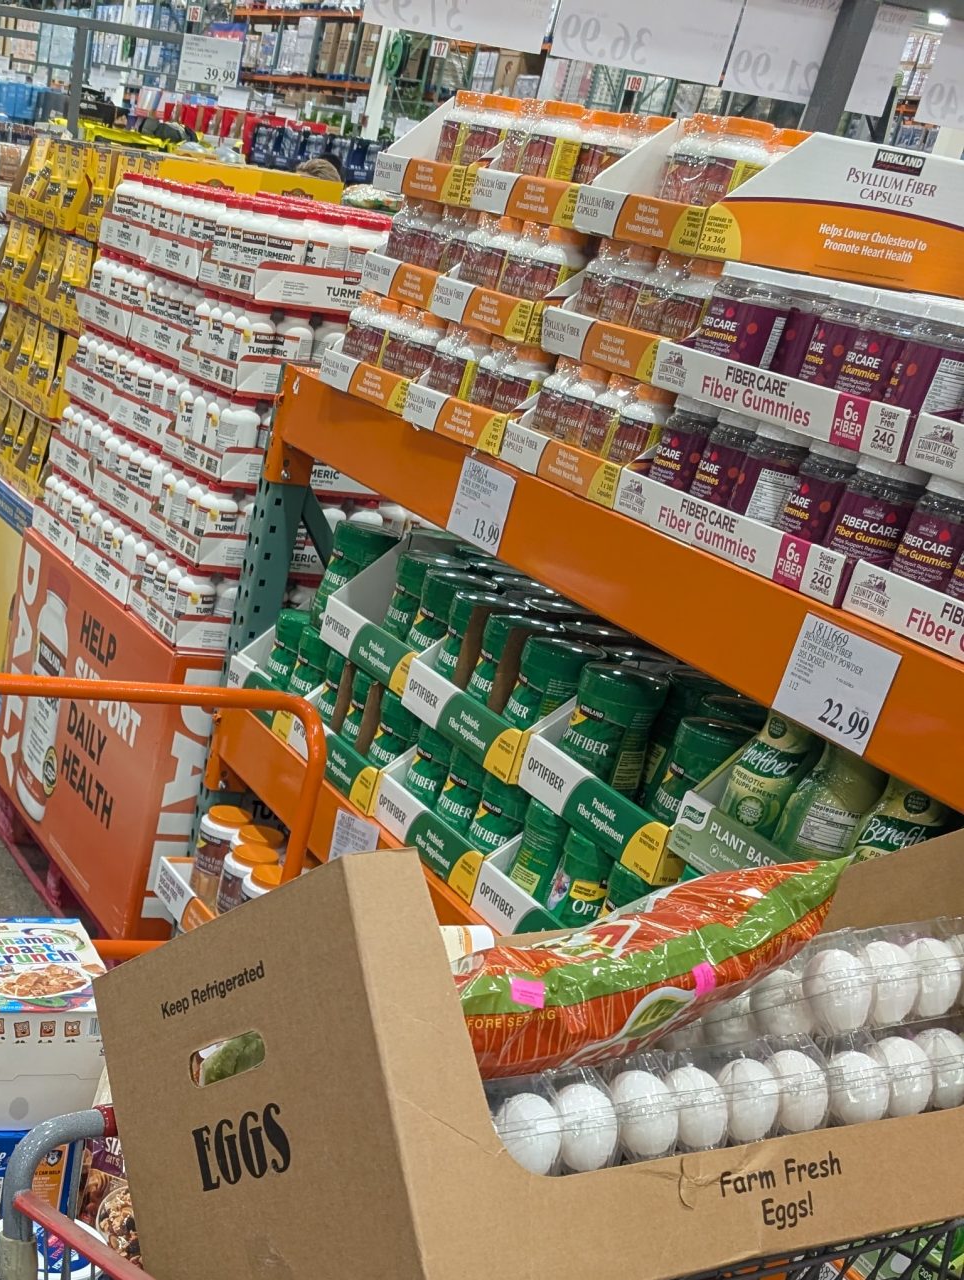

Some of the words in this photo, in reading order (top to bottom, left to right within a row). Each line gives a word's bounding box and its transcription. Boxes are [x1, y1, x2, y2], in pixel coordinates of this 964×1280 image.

[432, 41, 448, 57] 107
[204, 67, 236, 83] 39.99
[625, 76, 644, 91] 109
[876, 149, 925, 169] KIRKLAND
[845, 166, 905, 191] PSYLLIUM
[904, 176, 938, 198] FIBER
[859, 187, 915, 208] CAPSULES
[698, 242, 727, 254] Capsules
[713, 235, 726, 245] 360
[818, 222, 844, 237] Helps
[844, 226, 870, 241] Lower
[870, 231, 919, 249] Cholesterol
[918, 241, 927, 251] to
[822, 238, 861, 255] Promote
[861, 245, 884, 259] Heart
[885, 249, 913, 264] Health
[725, 365, 756, 389] FIBER
[755, 376, 789, 399] CARE
[700, 374, 740, 402] Fiber
[740, 391, 811, 428] Gummies
[879, 407, 900, 421] Sugar
[834, 417, 863, 438] FIBER
[879, 417, 896, 429] Free
[870, 443, 893, 454] GUMMIES
[873, 429, 895, 447] 240
[917, 437, 941, 452] COUNTRY
[940, 443, 959, 460] FARMS
[679, 498, 709, 520] FIBER
[708, 508, 738, 534] CARE
[841, 513, 869, 532] FIBER
[869, 522, 901, 539] CARE
[472, 518, 500, 546] 13.99
[657, 505, 692, 533] Fiber
[694, 521, 757, 564] Gummies
[854, 531, 898, 551] Gummies
[818, 551, 837, 565] Sugar
[909, 550, 953, 570] Gummies
[922, 539, 953, 558] CARE
[776, 558, 803, 579] FIBER
[818, 561, 834, 572] Free
[811, 571, 832, 589] 240
[79, 609, 118, 668] HELP
[324, 614, 352, 642] OPTIFIBER
[812, 620, 850, 648] 1811669
[906, 607, 954, 648] Fiber
[367, 637, 388, 659] Prebiotic
[800, 640, 837, 664] SUPPLEMENT
[837, 658, 864, 677] POWDER
[807, 653, 827, 669] DOSES
[835, 645, 854, 660] FIBER
[368, 655, 391, 676] Supplement
[408, 677, 438, 708] OPTIFIBER
[459, 709, 481, 731] Prebiotic
[580, 703, 605, 720] KIRKLAND
[817, 697, 871, 740] 22.99
[66, 699, 108, 768] DAILY
[447, 715, 464, 734] Fiber
[463, 725, 487, 752] Supplement
[59, 743, 114, 830] HEALTH
[526, 756, 567, 794] OPTIFIBER
[378, 793, 408, 826] OPTIFIBER
[591, 795, 618, 823] Prebiotic
[575, 802, 598, 824] Fiber
[593, 813, 626, 846] Supplement
[709, 821, 745, 854] PLANT
[479, 881, 516, 920] OPTIFIBER
[159, 997, 191, 1020] Keep
[190, 959, 267, 1007] Refrigerated
[191, 1102, 292, 1192] EGGS
[719, 1169, 777, 1198] Farm
[783, 1149, 843, 1186] Fresh
[761, 1190, 815, 1231] Eggs!
